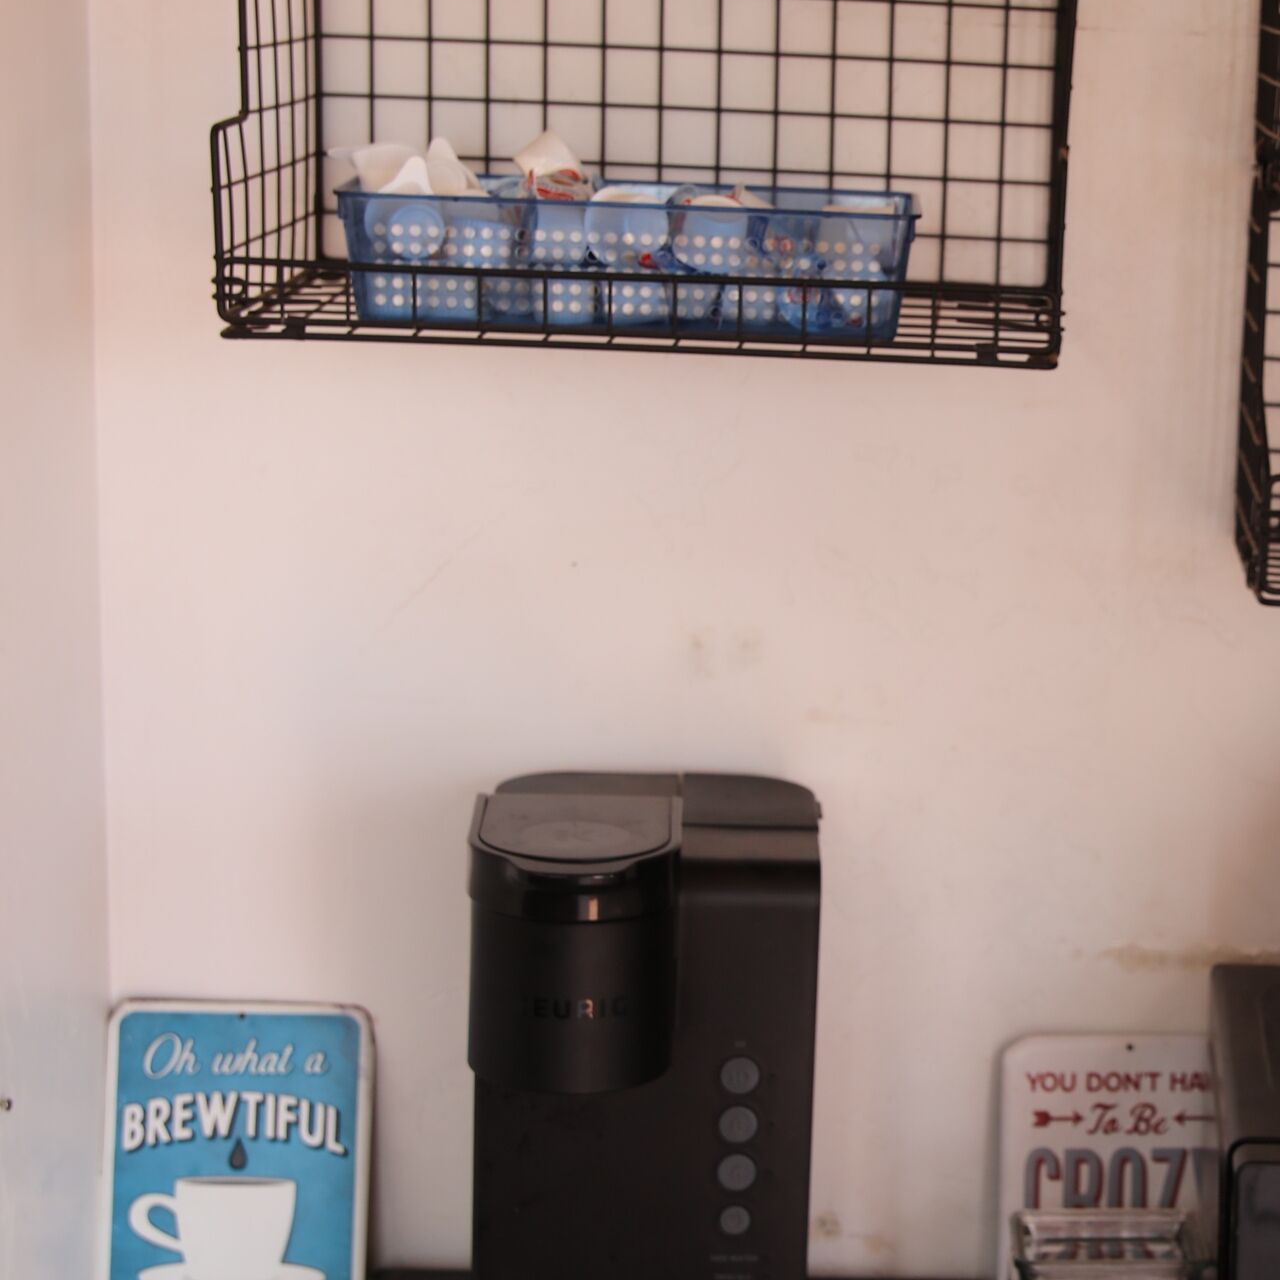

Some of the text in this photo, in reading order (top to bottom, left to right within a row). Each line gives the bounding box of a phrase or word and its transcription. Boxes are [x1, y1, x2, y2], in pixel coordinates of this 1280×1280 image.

[143, 1031, 329, 1080] Oh what a
[1026, 1071, 1076, 1094] YOU
[1086, 1071, 1161, 1094] DON'T
[121, 1089, 348, 1157] BREWTIFUL
[1086, 1101, 1169, 1136] To Be
